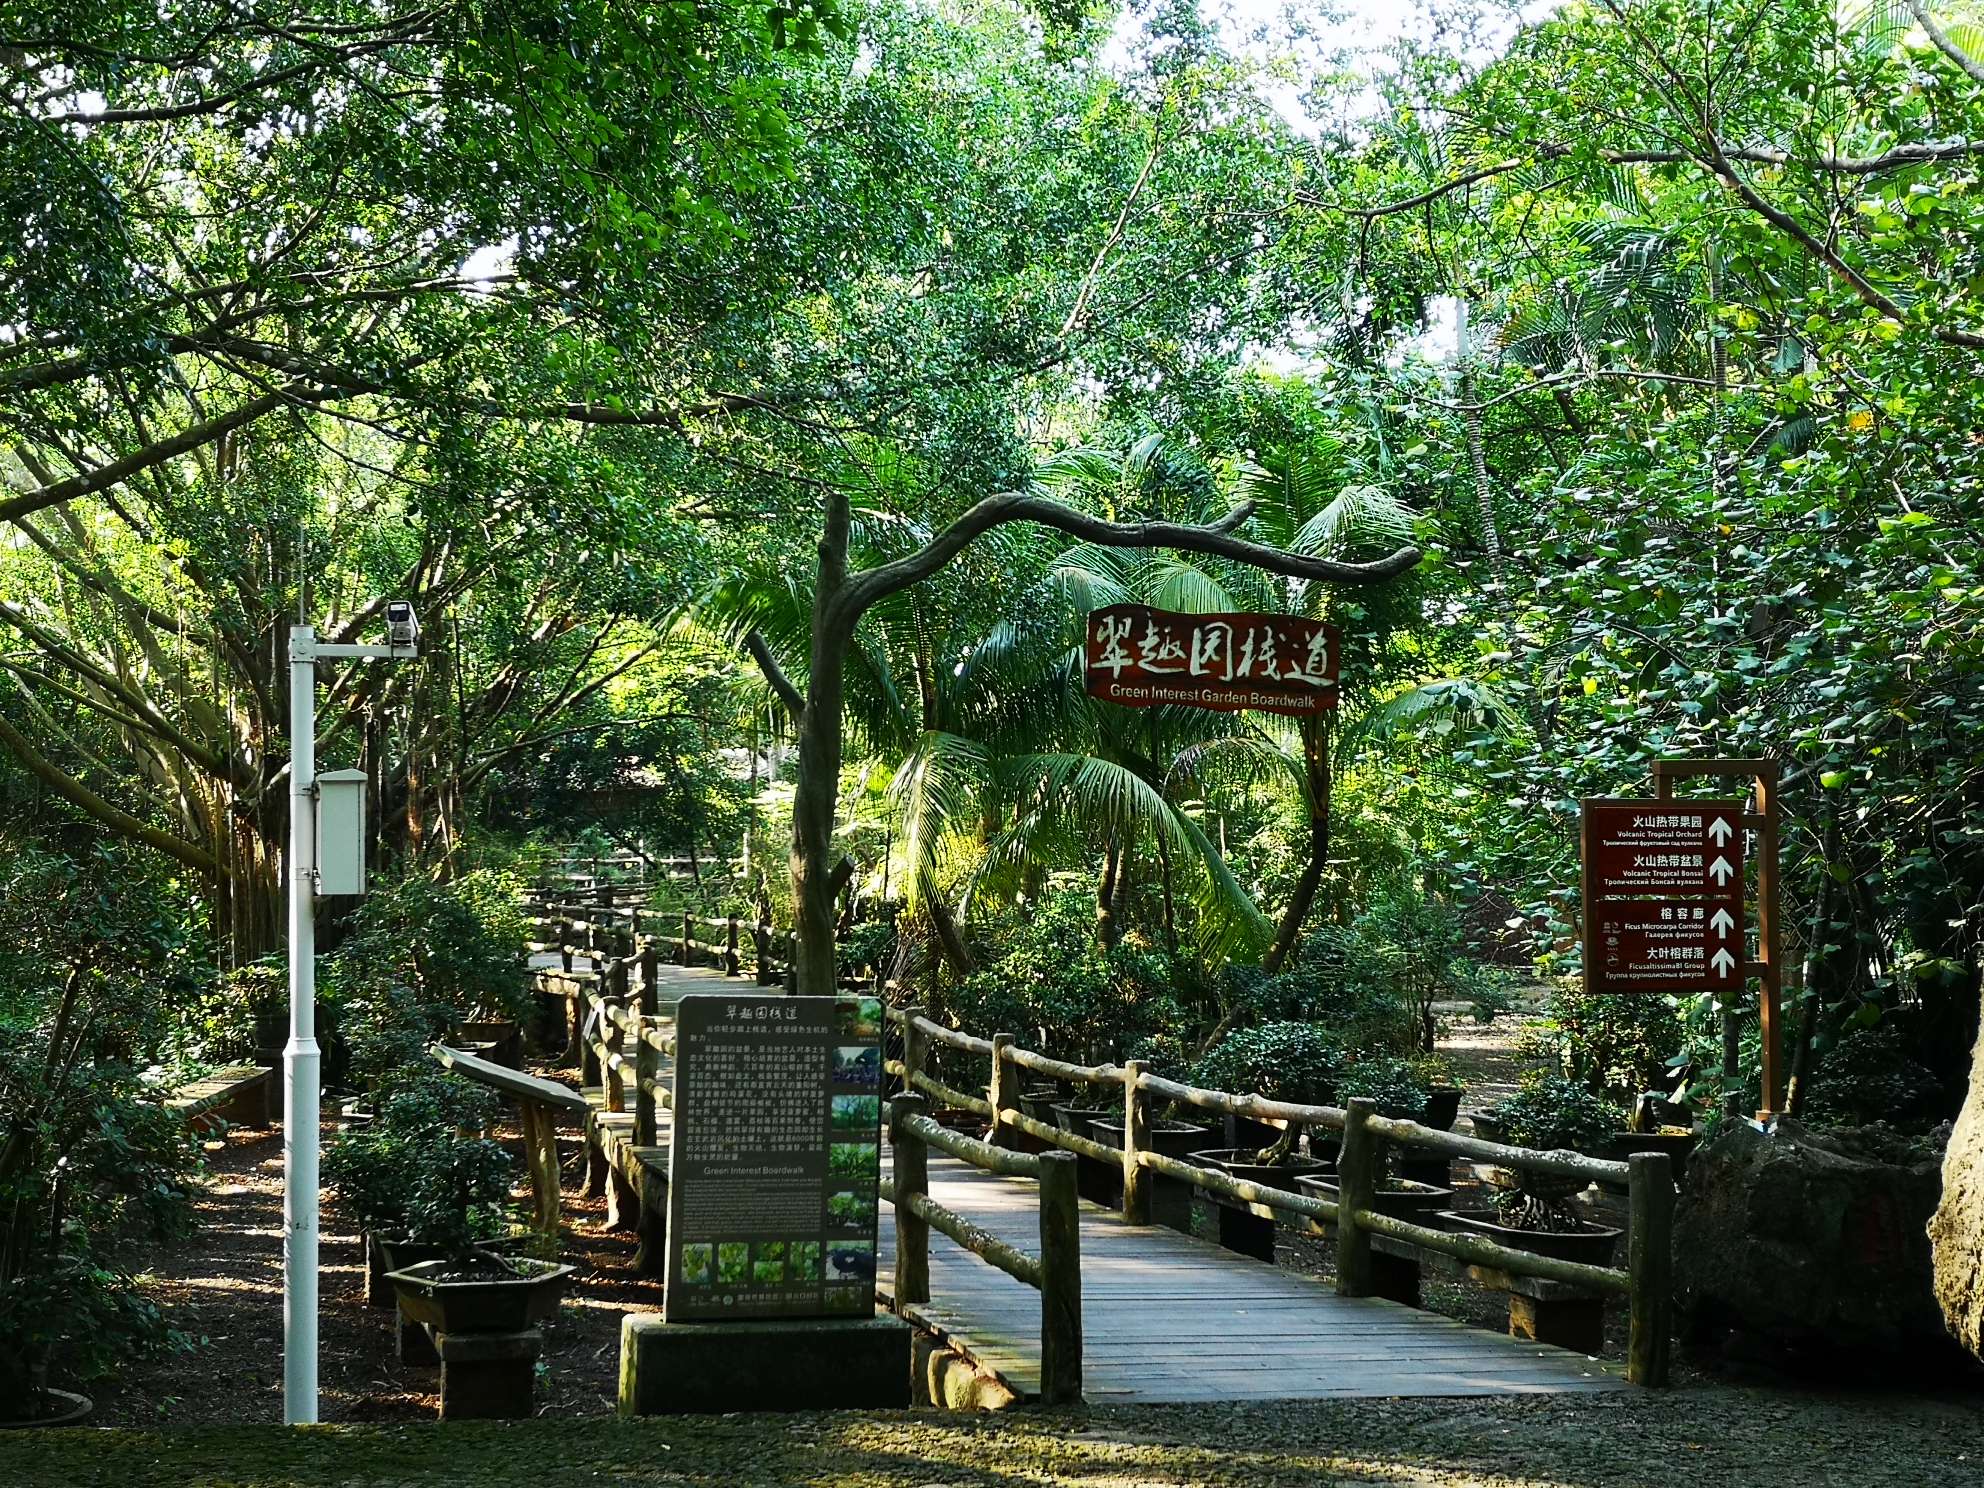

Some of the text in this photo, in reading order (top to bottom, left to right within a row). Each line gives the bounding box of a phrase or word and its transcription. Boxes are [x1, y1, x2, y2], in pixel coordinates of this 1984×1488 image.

[1090, 613, 1335, 686] 翠趣园栈道
[1110, 683, 1315, 709] Green Interest Garden Boardwalk
[1632, 815, 1702, 828] 火山热带果园
[1617, 830, 1703, 839] Volcanic Tropical Orchard
[1633, 854, 1703, 867] 火山热带盆景
[1653, 870, 1680, 878] Tropical
[1642, 923, 1677, 931] Microcarpa
[1647, 947, 1705, 960] 大叶榕群落
[1684, 963, 1705, 971] Group
[703, 1166, 729, 1175] Green
